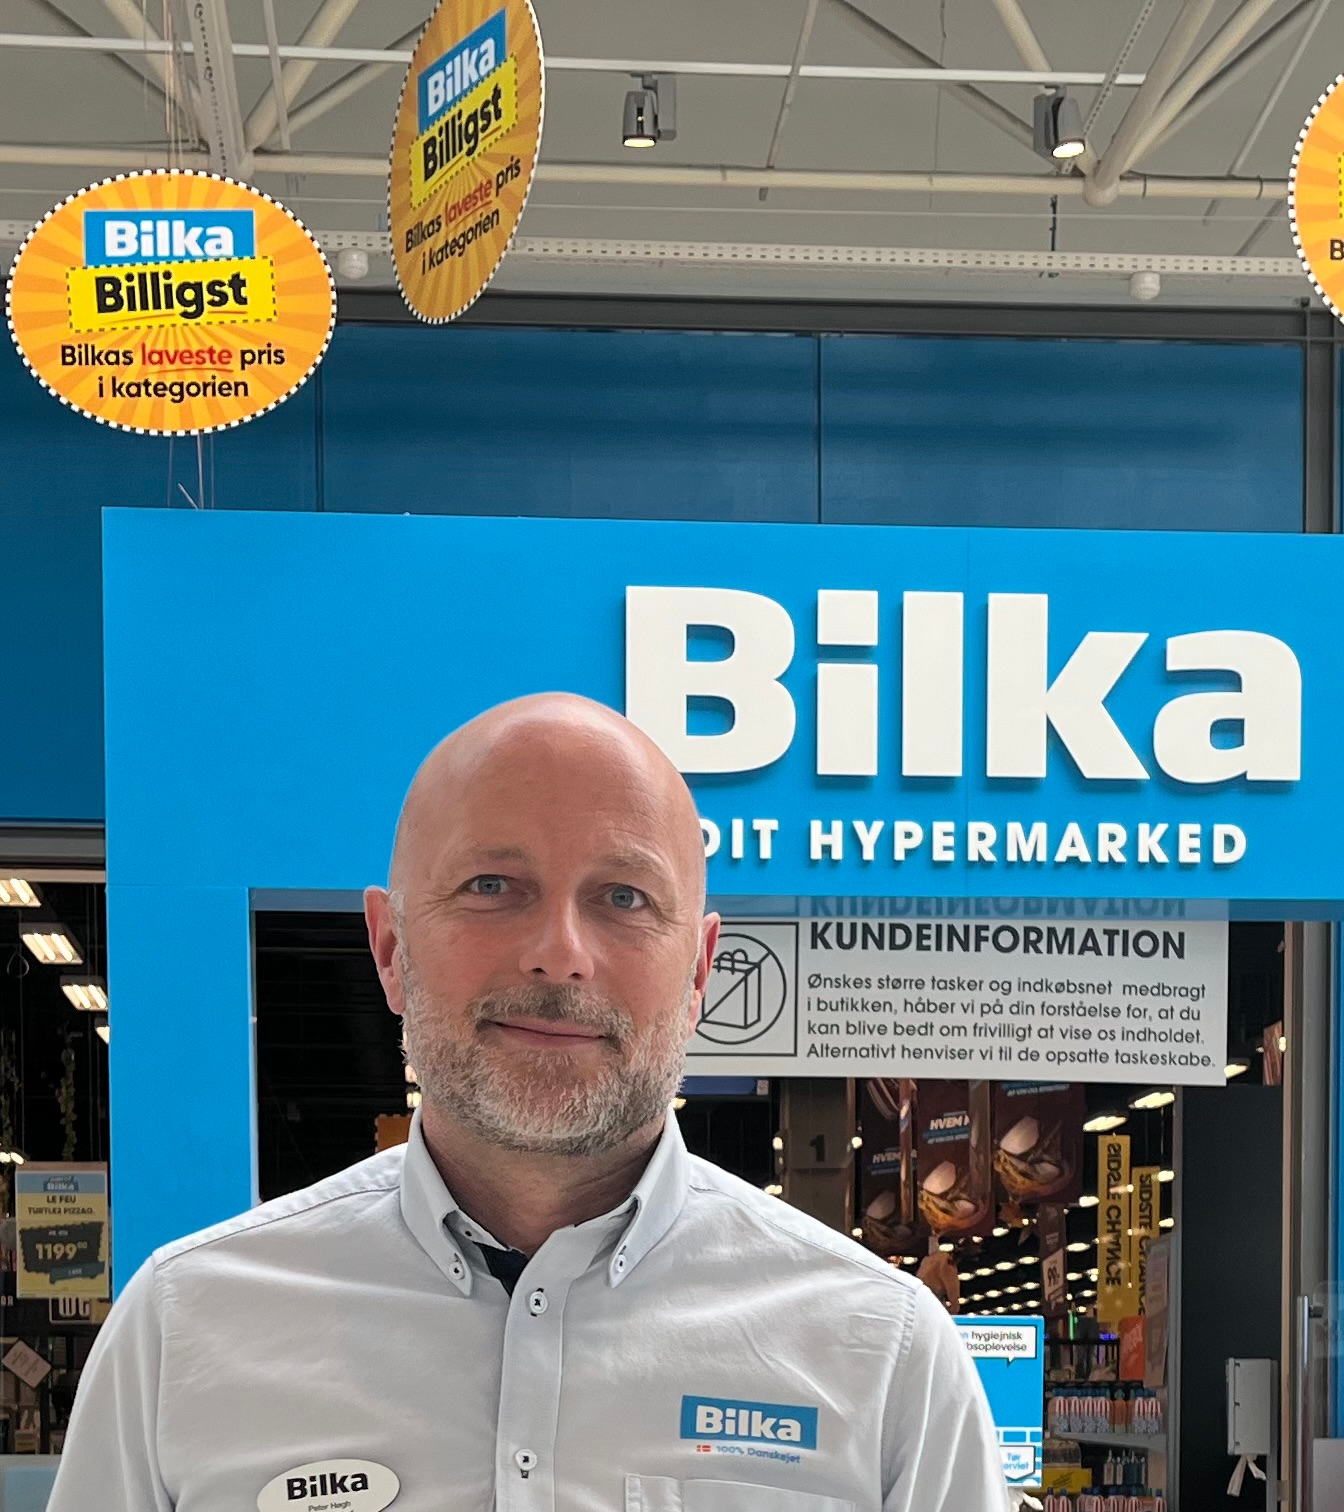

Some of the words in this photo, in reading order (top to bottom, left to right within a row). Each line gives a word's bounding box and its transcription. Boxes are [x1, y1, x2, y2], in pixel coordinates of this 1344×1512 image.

[428, 37, 496, 117] Bilka
[423, 83, 502, 182] Billigst
[405, 214, 442, 252] Bilkas
[445, 177, 492, 223] laveste
[496, 155, 521, 197] pris
[105, 220, 233, 257] Bilka
[422, 252, 426, 275] i
[429, 208, 499, 269] kategorien
[95, 271, 248, 319] Billigst
[61, 344, 133, 366] Bilkas
[142, 343, 232, 365] laveste
[240, 343, 285, 371] pris
[98, 377, 104, 397] i
[112, 375, 249, 403] kategorien
[624, 585, 1303, 785] Bilka
[810, 820, 1248, 865] HYPERMARKED
[810, 921, 1186, 960] KUNDEINFORMATION
[807, 973, 871, 990] Ønskes
[877, 975, 925, 991] større
[931, 976, 984, 993] tasker
[989, 980, 1012, 996] og
[1017, 978, 1112, 996] indkøbsnet
[1122, 982, 1206, 1001] medbragt
[807, 998, 811, 1012] i
[817, 998, 898, 1015] butikken,
[904, 999, 955, 1014] håber
[961, 1000, 975, 1015] vi
[981, 999, 1004, 1019] på
[1010, 1001, 1035, 1017] din
[1040, 1001, 1121, 1019] forståelse
[1127, 1003, 1152, 1022] for,
[1158, 1005, 1175, 1020] at
[1180, 1004, 1201, 1022] du
[807, 1021, 840, 1036] kan
[846, 1022, 887, 1037] blive
[893, 1022, 935, 1037] bedt
[940, 1025, 967, 1038] om
[972, 1023, 1032, 1042] frivilligt
[1037, 1025, 1055, 1039] at
[1060, 1025, 1091, 1040] vise
[1097, 1028, 1116, 1041] os
[1121, 1027, 1205, 1045] indholdet.
[807, 1043, 896, 1059] Alternativt
[901, 1045, 974, 1061] henviser
[979, 1047, 993, 1061] vi
[999, 1046, 1012, 1061] til
[1017, 1047, 1040, 1063] de
[1045, 1048, 1109, 1066] opsatte
[1115, 1050, 1216, 1068] taskeskabe.
[36, 1243, 76, 1260] 1199
[971, 1331, 1023, 1342] hygiejnisk
[696, 1405, 801, 1442] Bilka
[716, 1445, 744, 1455] 100%
[747, 1448, 801, 1463] Danskejet
[287, 1472, 369, 1500] Bilka
